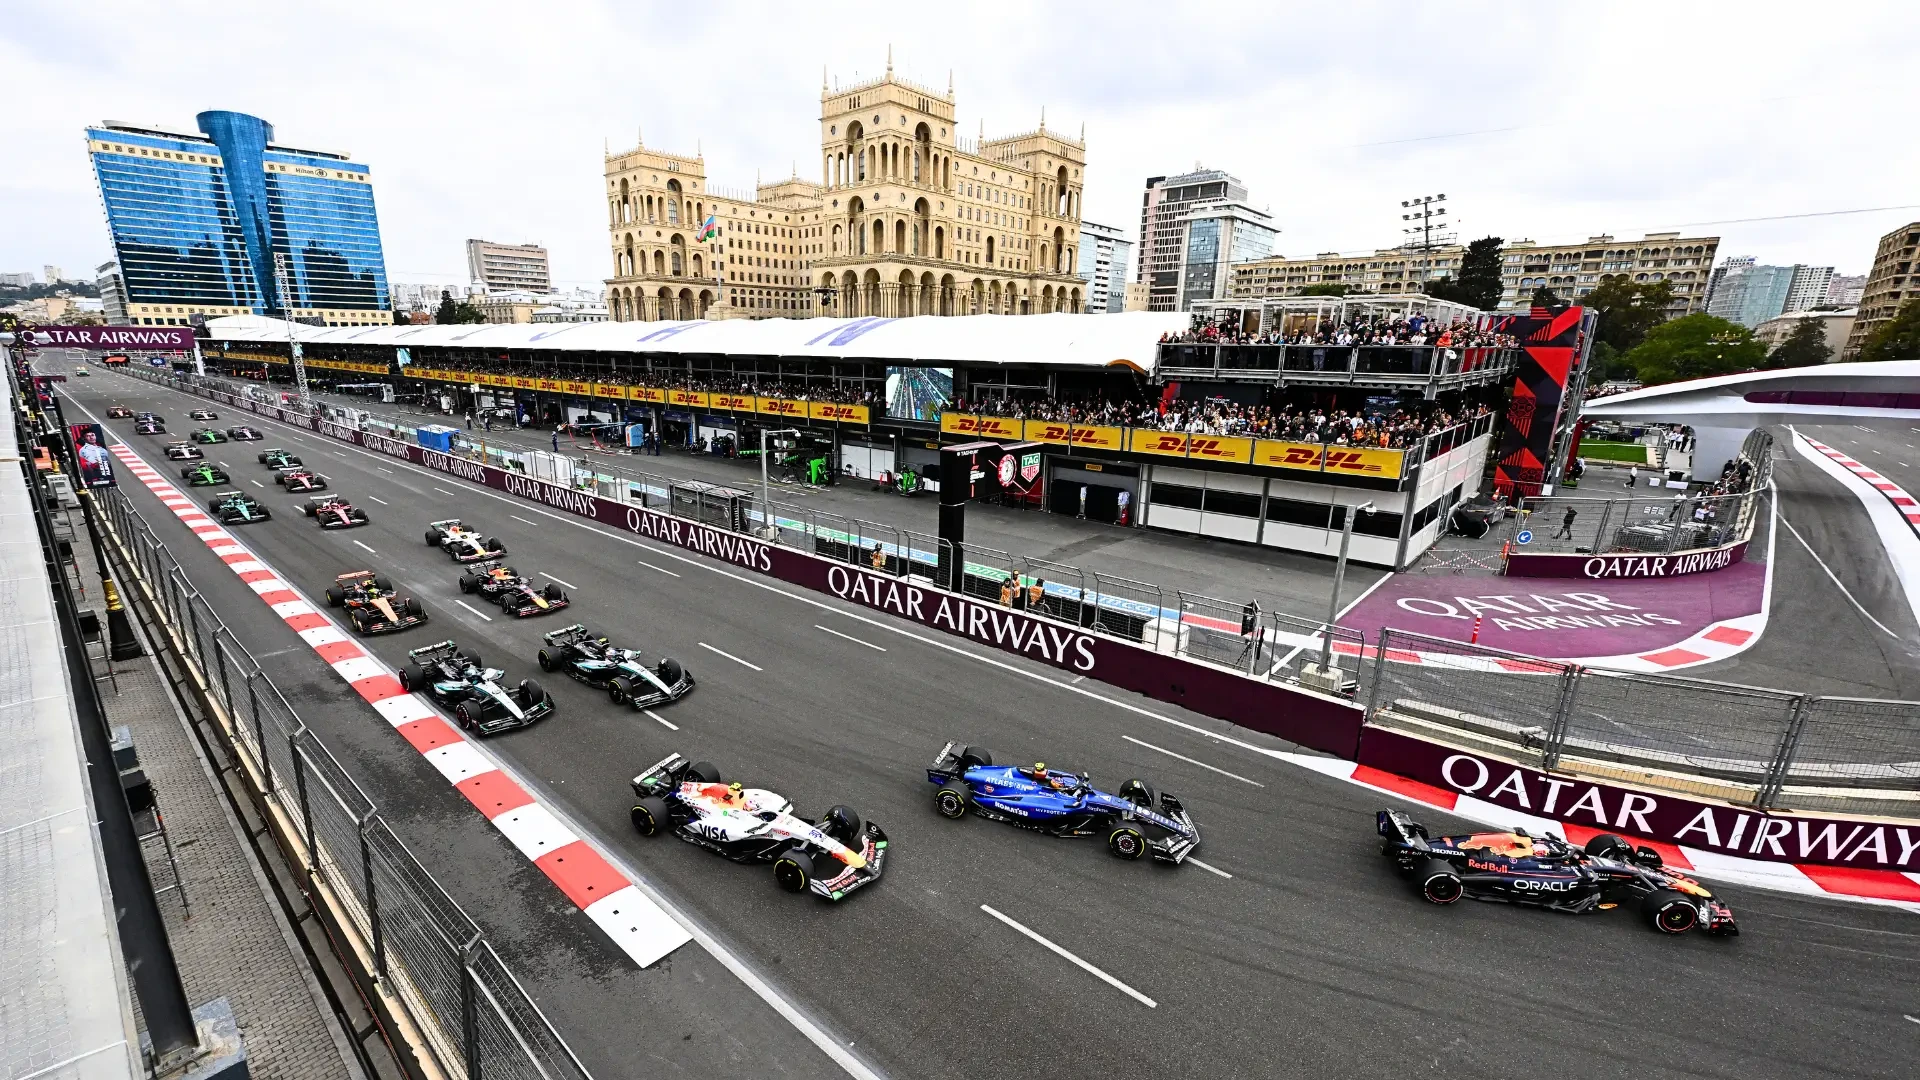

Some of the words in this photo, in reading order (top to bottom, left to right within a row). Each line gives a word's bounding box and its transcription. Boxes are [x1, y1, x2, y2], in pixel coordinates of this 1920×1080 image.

[99, 330, 182, 344] AIRWAYS
[517, 379, 531, 387] DHL
[541, 381, 556, 390] DHL
[568, 384, 584, 393] DHL
[600, 386, 618, 396] DHL
[636, 389, 656, 400] DHL
[677, 393, 700, 404] DHL
[720, 397, 745, 408] DHL
[768, 401, 796, 413] DHL
[822, 406, 854, 419] DHL
[958, 418, 1001, 434] DHL
[1044, 427, 1098, 441] DHL
[362, 433, 382, 451] QATAR
[383, 438, 410, 459] AIRWAYS
[1156, 436, 1223, 456] DHL
[1023, 456, 1039, 466] TAG
[1282, 448, 1366, 470] DHL
[422, 451, 449, 472] QATAR
[449, 457, 486, 483] AIRWAYS
[504, 474, 542, 501] QATAR
[544, 484, 597, 518] AIRWAYS
[626, 508, 683, 545] QATAR
[687, 525, 771, 571] AIRWAYS
[1584, 558, 1667, 579] QATAR
[1670, 548, 1733, 575] AIRWAYS
[1396, 592, 1641, 620] QATAR
[828, 566, 925, 620] QATAR
[933, 596, 1096, 671] AIRWAYS
[1490, 613, 1681, 632] AIRWAYS
[985, 776, 1034, 791] ATLASSIAN
[1441, 754, 1657, 834] QATAR
[994, 801, 1029, 817] KOMATSU
[698, 823, 729, 841] VISA
[1431, 848, 1466, 857] HONDA
[1468, 858, 1488, 870] Red
[1489, 862, 1508, 873] Bull
[842, 882, 859, 892] Cash
[858, 875, 871, 885] App
[1514, 880, 1579, 892] ORACLE
